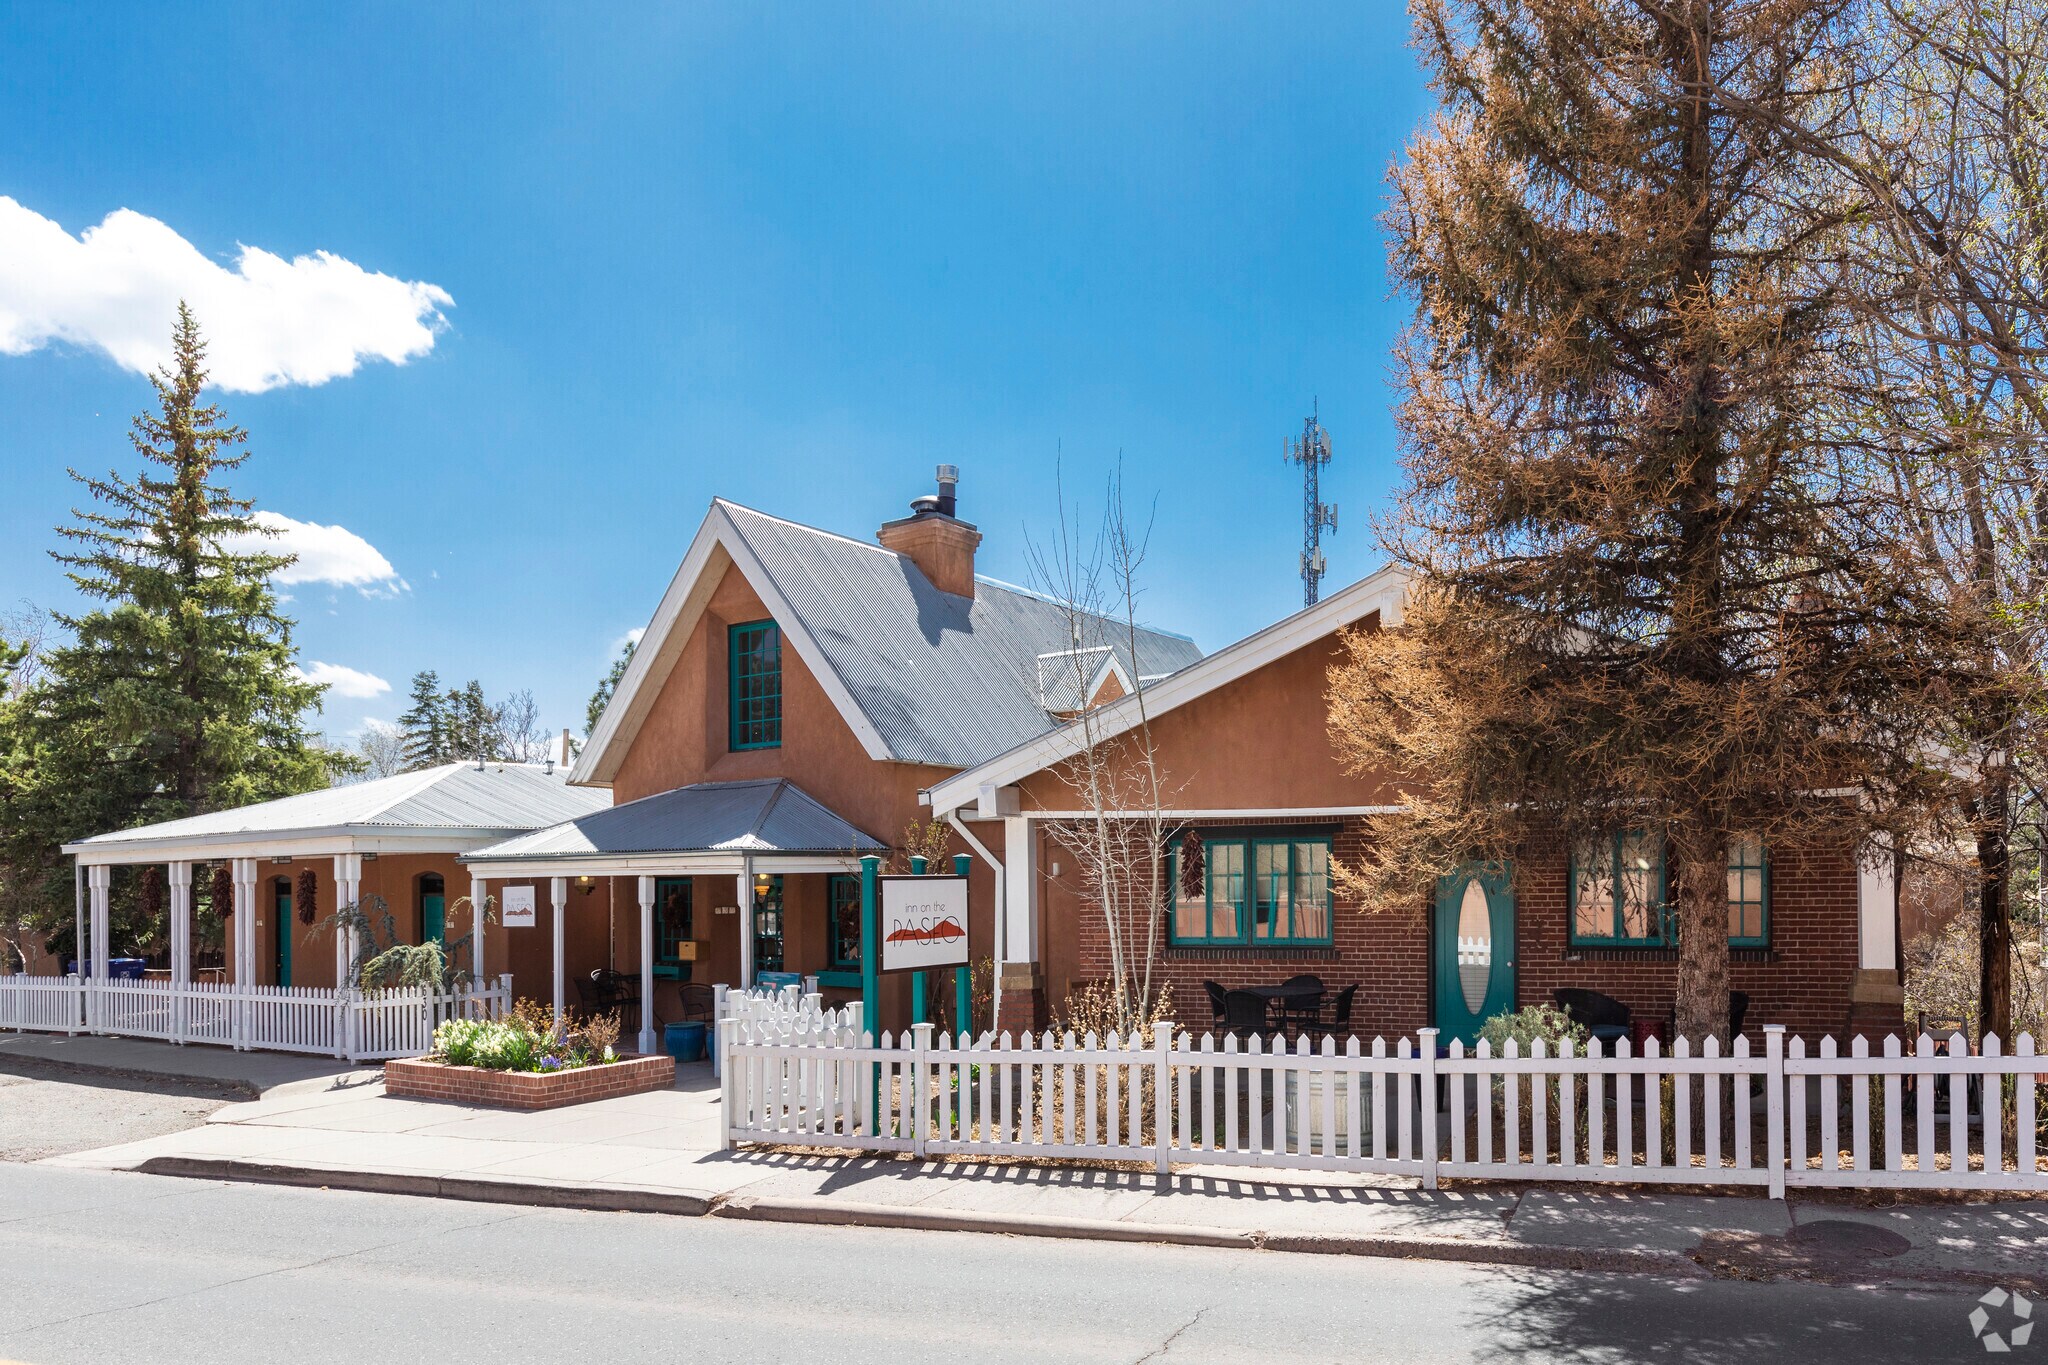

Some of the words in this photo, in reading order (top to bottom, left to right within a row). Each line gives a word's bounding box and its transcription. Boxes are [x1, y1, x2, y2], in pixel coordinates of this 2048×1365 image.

[905, 904, 917, 912] inn
[921, 904, 930, 912] on
[934, 902, 945, 911] the
[894, 916, 960, 947] PASEO
